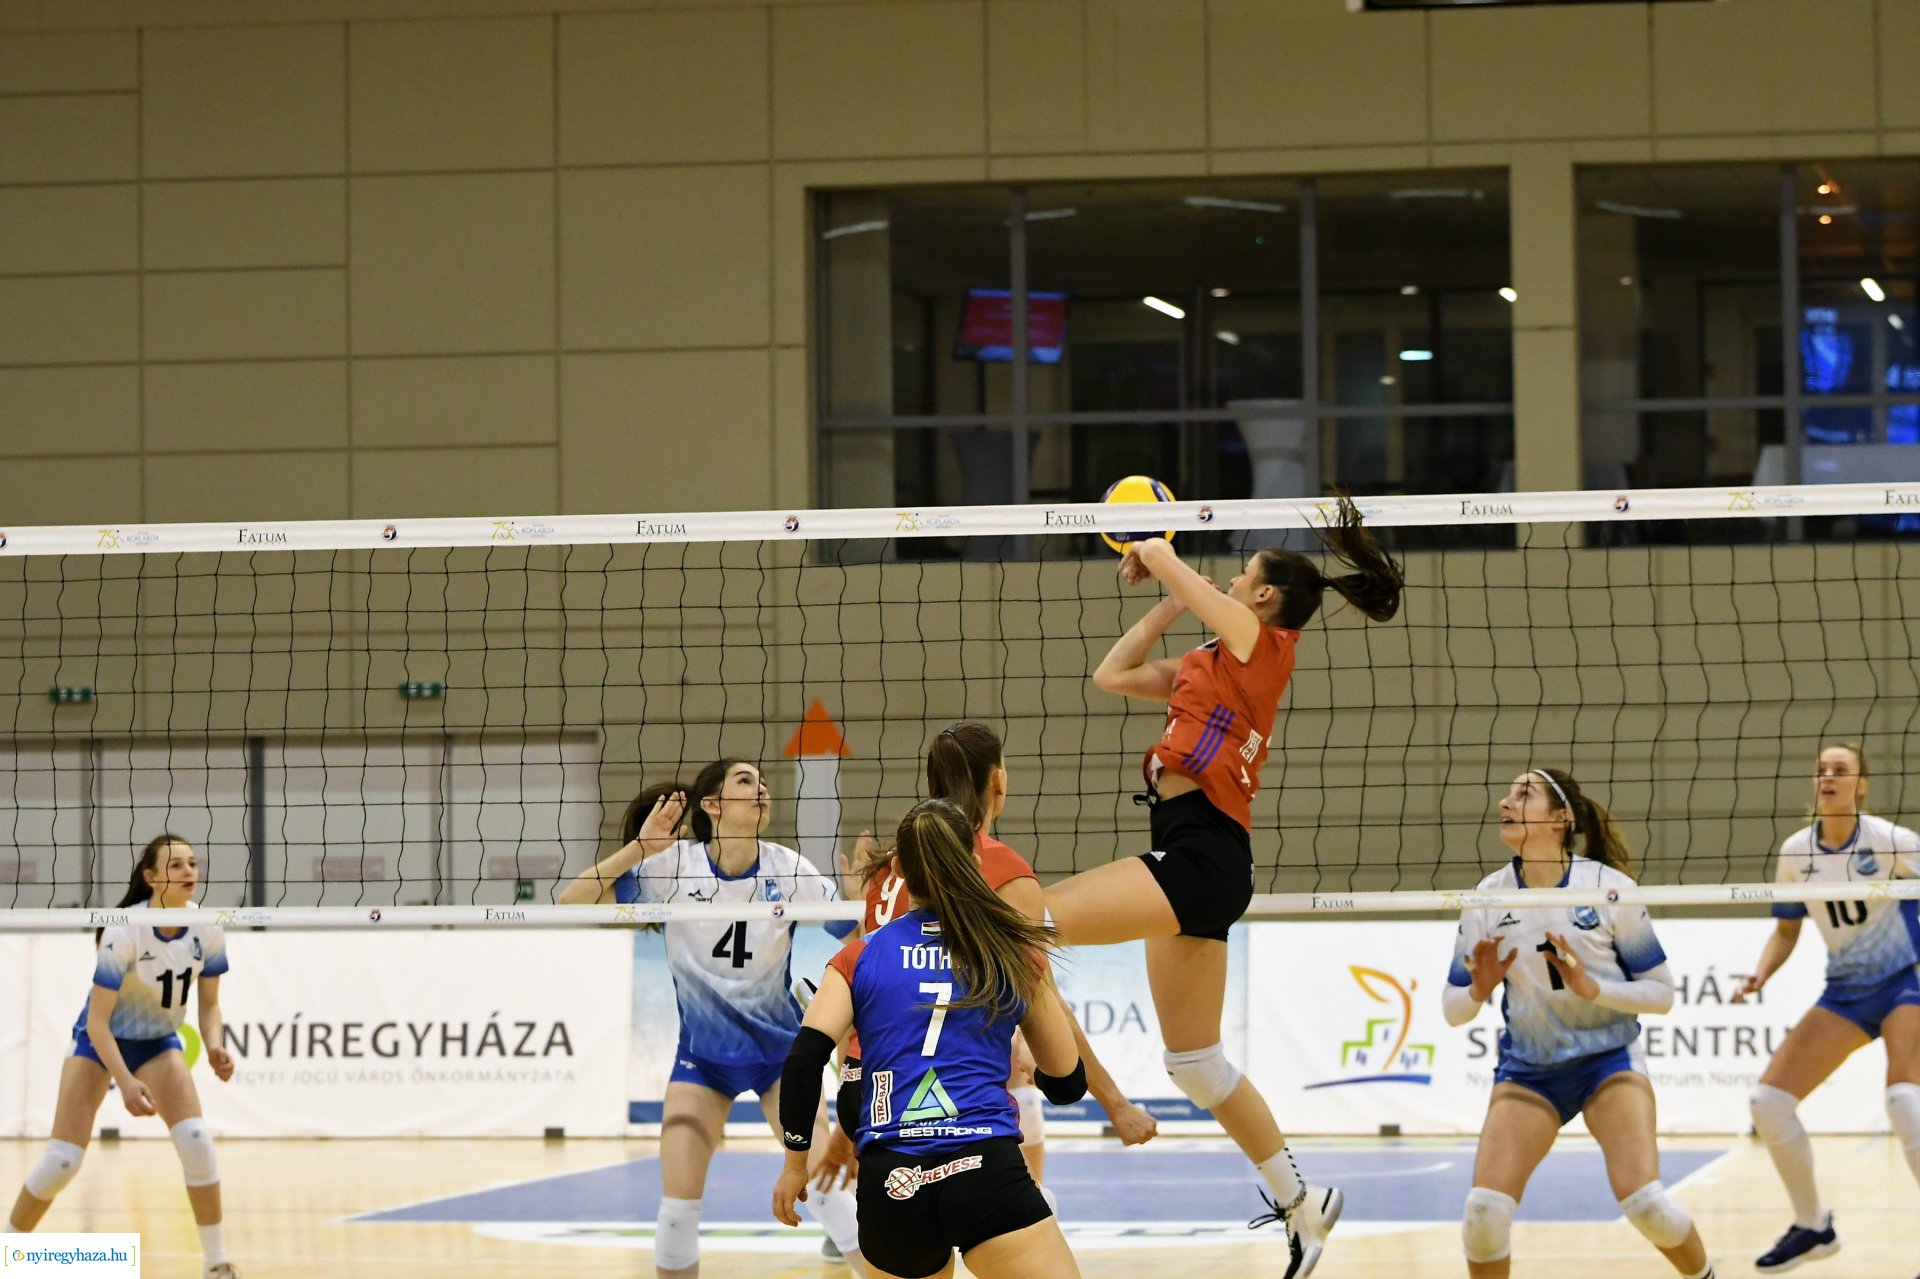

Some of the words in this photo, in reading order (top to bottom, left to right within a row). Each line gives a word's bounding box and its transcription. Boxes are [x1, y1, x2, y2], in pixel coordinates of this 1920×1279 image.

[1884, 489, 1920, 505] FATU
[1825, 900, 1868, 929] 10
[712, 920, 753, 968] 4
[900, 943, 953, 970] TÓTH
[156, 967, 192, 1009] 11
[221, 1012, 575, 1058] NYÍREGYHÁZA
[919, 982, 953, 1057] 7
[233, 1068, 285, 1085] EGYEI
[876, 1074, 888, 1123] STRABAG
[899, 1126, 993, 1138] BESTRONG
